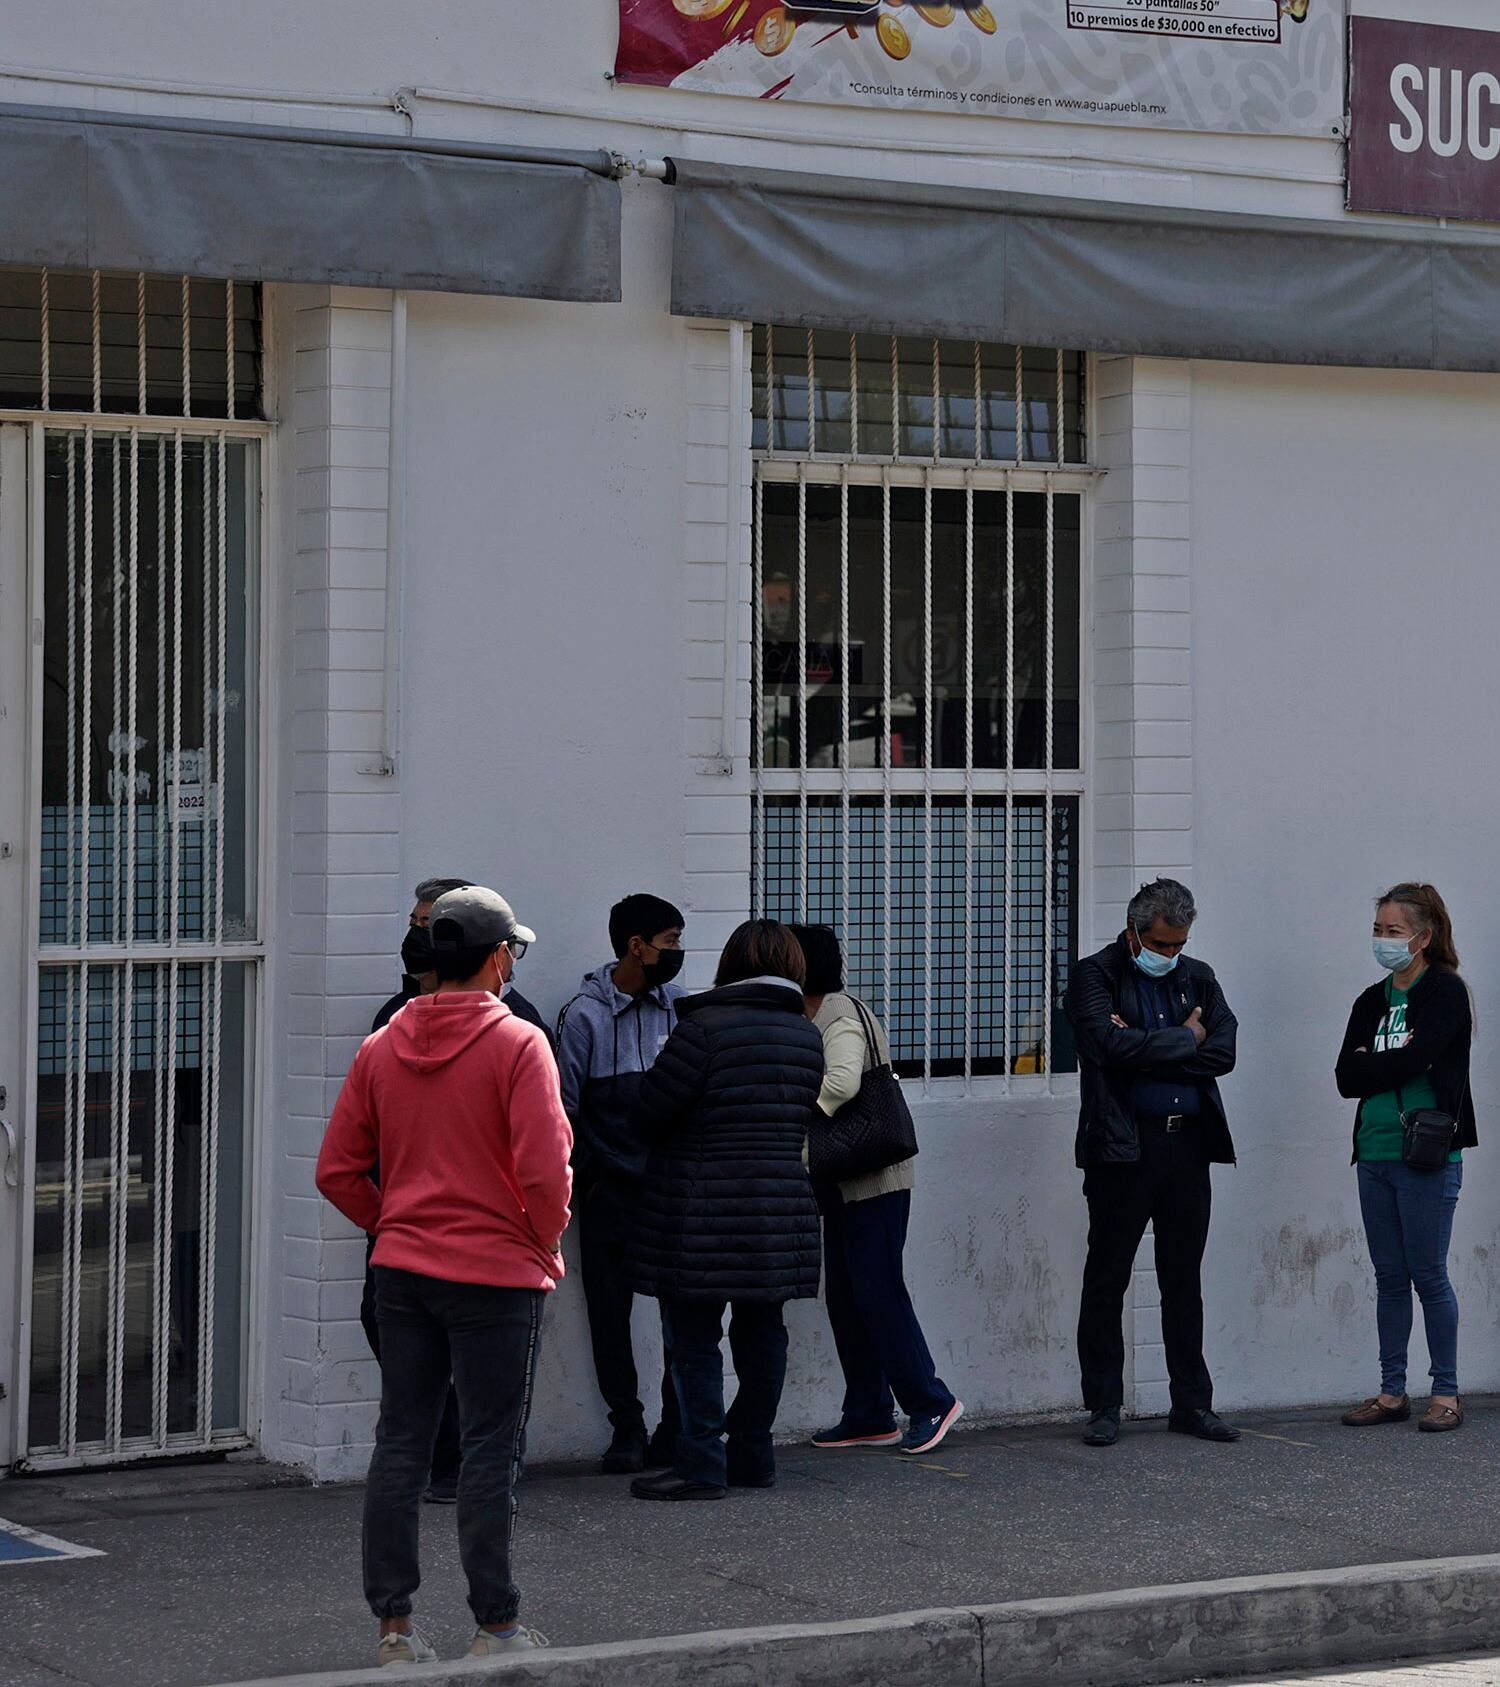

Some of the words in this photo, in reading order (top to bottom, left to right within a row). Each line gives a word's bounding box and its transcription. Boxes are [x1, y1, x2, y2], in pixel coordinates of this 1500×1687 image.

[1146, 0, 1198, 10] pantallas
[1070, 11, 1085, 23] 10
[1087, 14, 1139, 28] premios
[1141, 16, 1155, 29] de
[1157, 16, 1205, 33] $30,000
[1207, 24, 1222, 34] en
[1224, 23, 1275, 37] efectivo
[907, 86, 958, 101] términos
[960, 91, 968, 104] y
[969, 91, 1035, 106] condiciones
[1037, 97, 1052, 107] en
[1054, 98, 1167, 114] www.aguapuebla.mx
[178, 796, 205, 808] 2022
